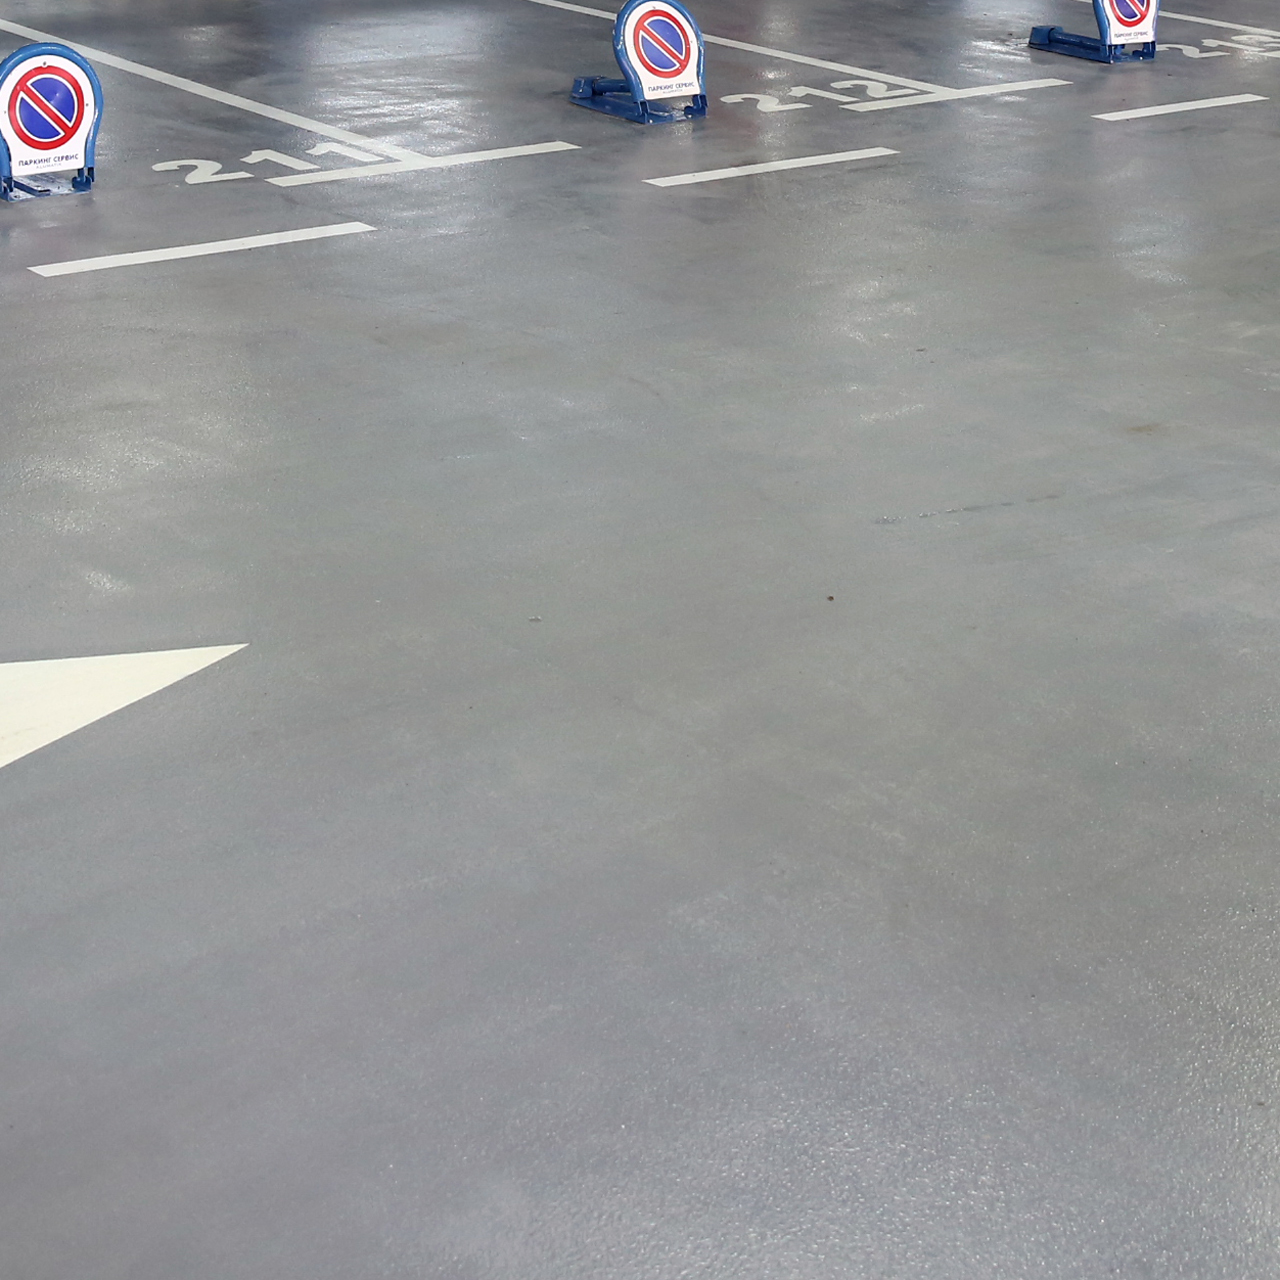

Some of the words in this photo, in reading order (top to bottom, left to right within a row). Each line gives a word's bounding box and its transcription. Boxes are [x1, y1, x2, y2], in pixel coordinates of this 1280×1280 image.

[720, 79, 920, 113] 212
[18, 157, 52, 167] ПАРКИНГ
[53, 153, 79, 163] СЕРВИС
[152, 140, 384, 186] 211
